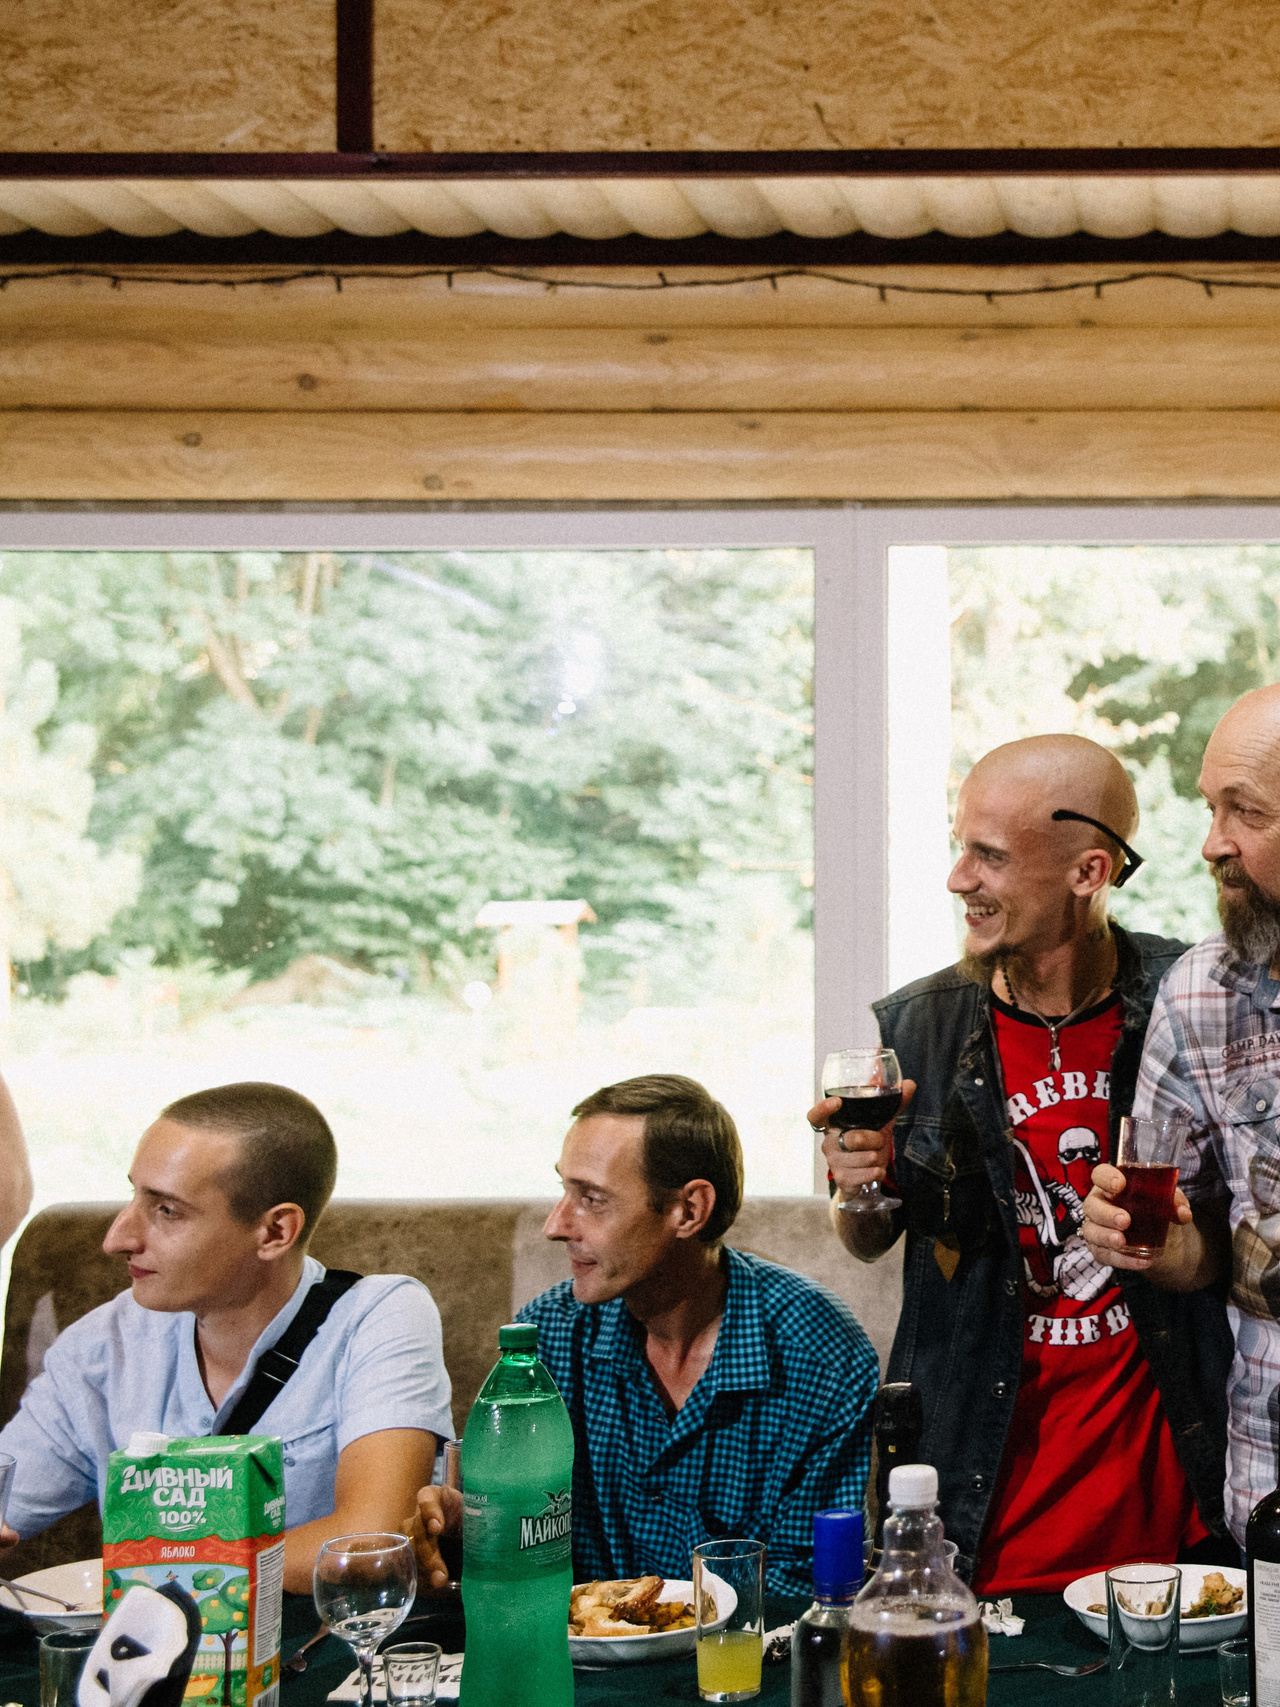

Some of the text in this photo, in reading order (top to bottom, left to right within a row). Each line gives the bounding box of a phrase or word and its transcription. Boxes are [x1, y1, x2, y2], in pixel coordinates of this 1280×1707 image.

[1222, 1038, 1254, 1058] CAMP
[1028, 1301, 1130, 1345] THE B
[121, 1465, 233, 1494] ДИВНЫЙ
[153, 1487, 207, 1509] САД
[159, 1510, 207, 1525] 100%
[520, 1513, 572, 1550] МАЙКОП
[161, 1546, 196, 1558] ЯБЛОКО
